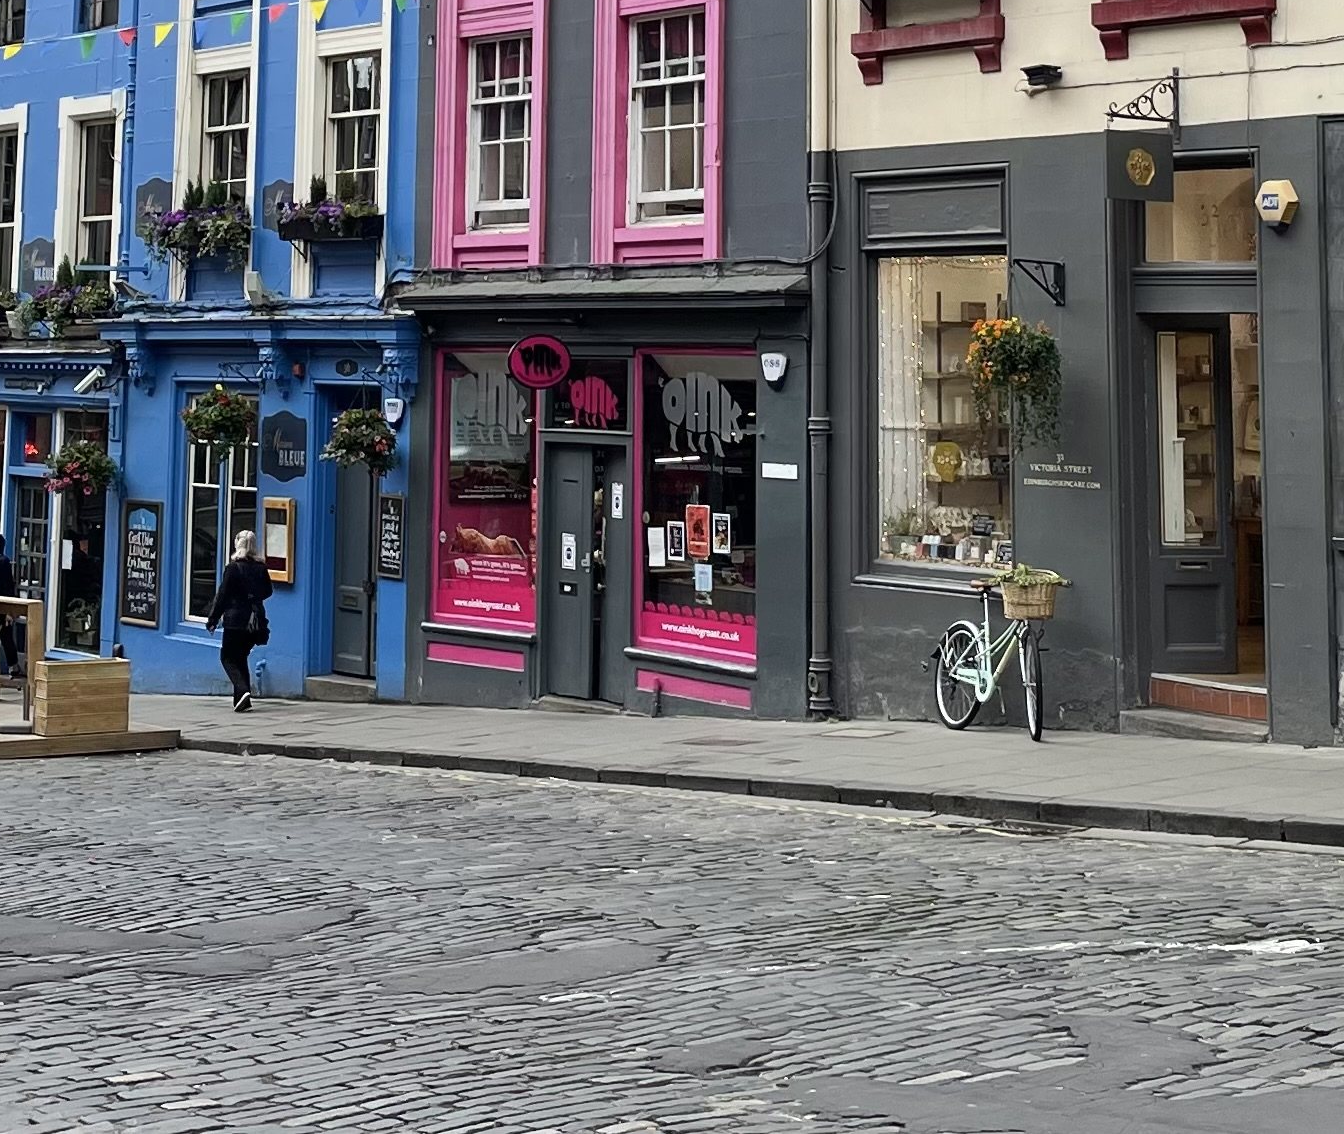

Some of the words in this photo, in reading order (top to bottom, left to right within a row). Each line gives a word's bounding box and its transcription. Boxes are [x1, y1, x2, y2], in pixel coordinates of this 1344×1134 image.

[1262, 197, 1279, 208] ADT
[278, 450, 305, 466] BLEUE
[1029, 463, 1062, 473] VICTORIA
[1063, 465, 1093, 474] STREET
